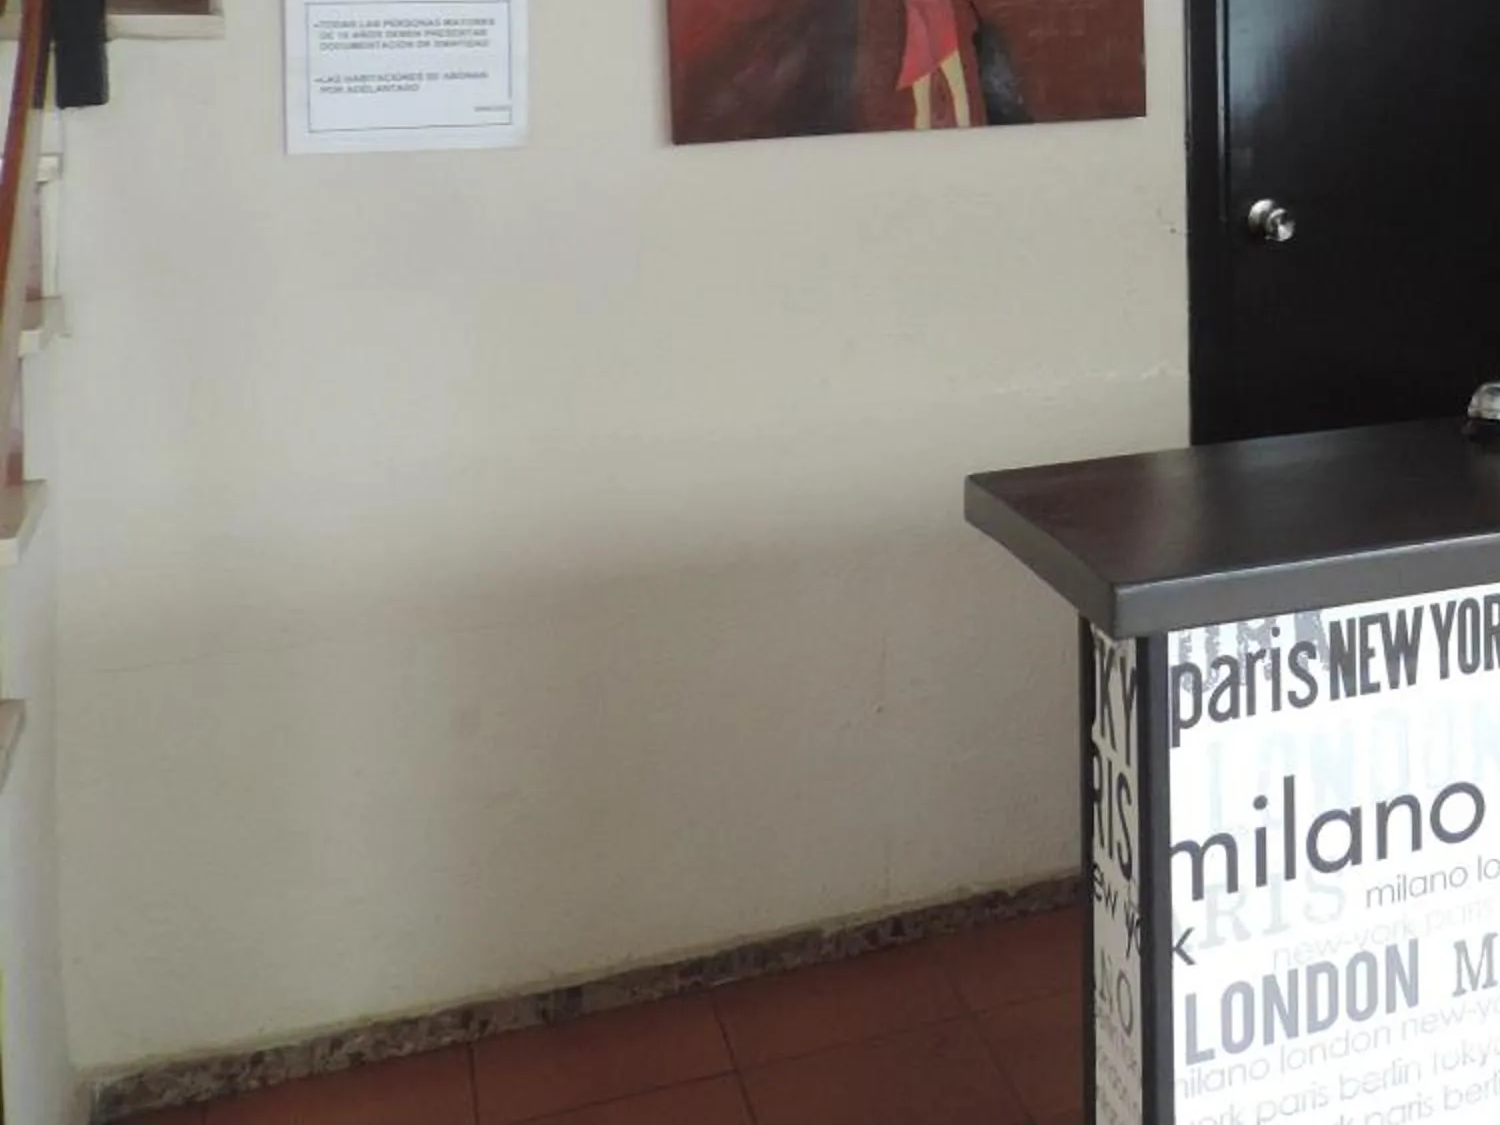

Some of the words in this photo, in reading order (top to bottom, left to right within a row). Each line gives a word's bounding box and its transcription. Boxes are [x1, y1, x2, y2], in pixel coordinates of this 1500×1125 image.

[1168, 618, 1321, 750] paris
[1325, 604, 1425, 702] NEW
[1169, 773, 1486, 913] milano
[1365, 865, 1469, 909] milano
[1184, 937, 1419, 1066] LONDON
[1279, 1024, 1392, 1076] london
